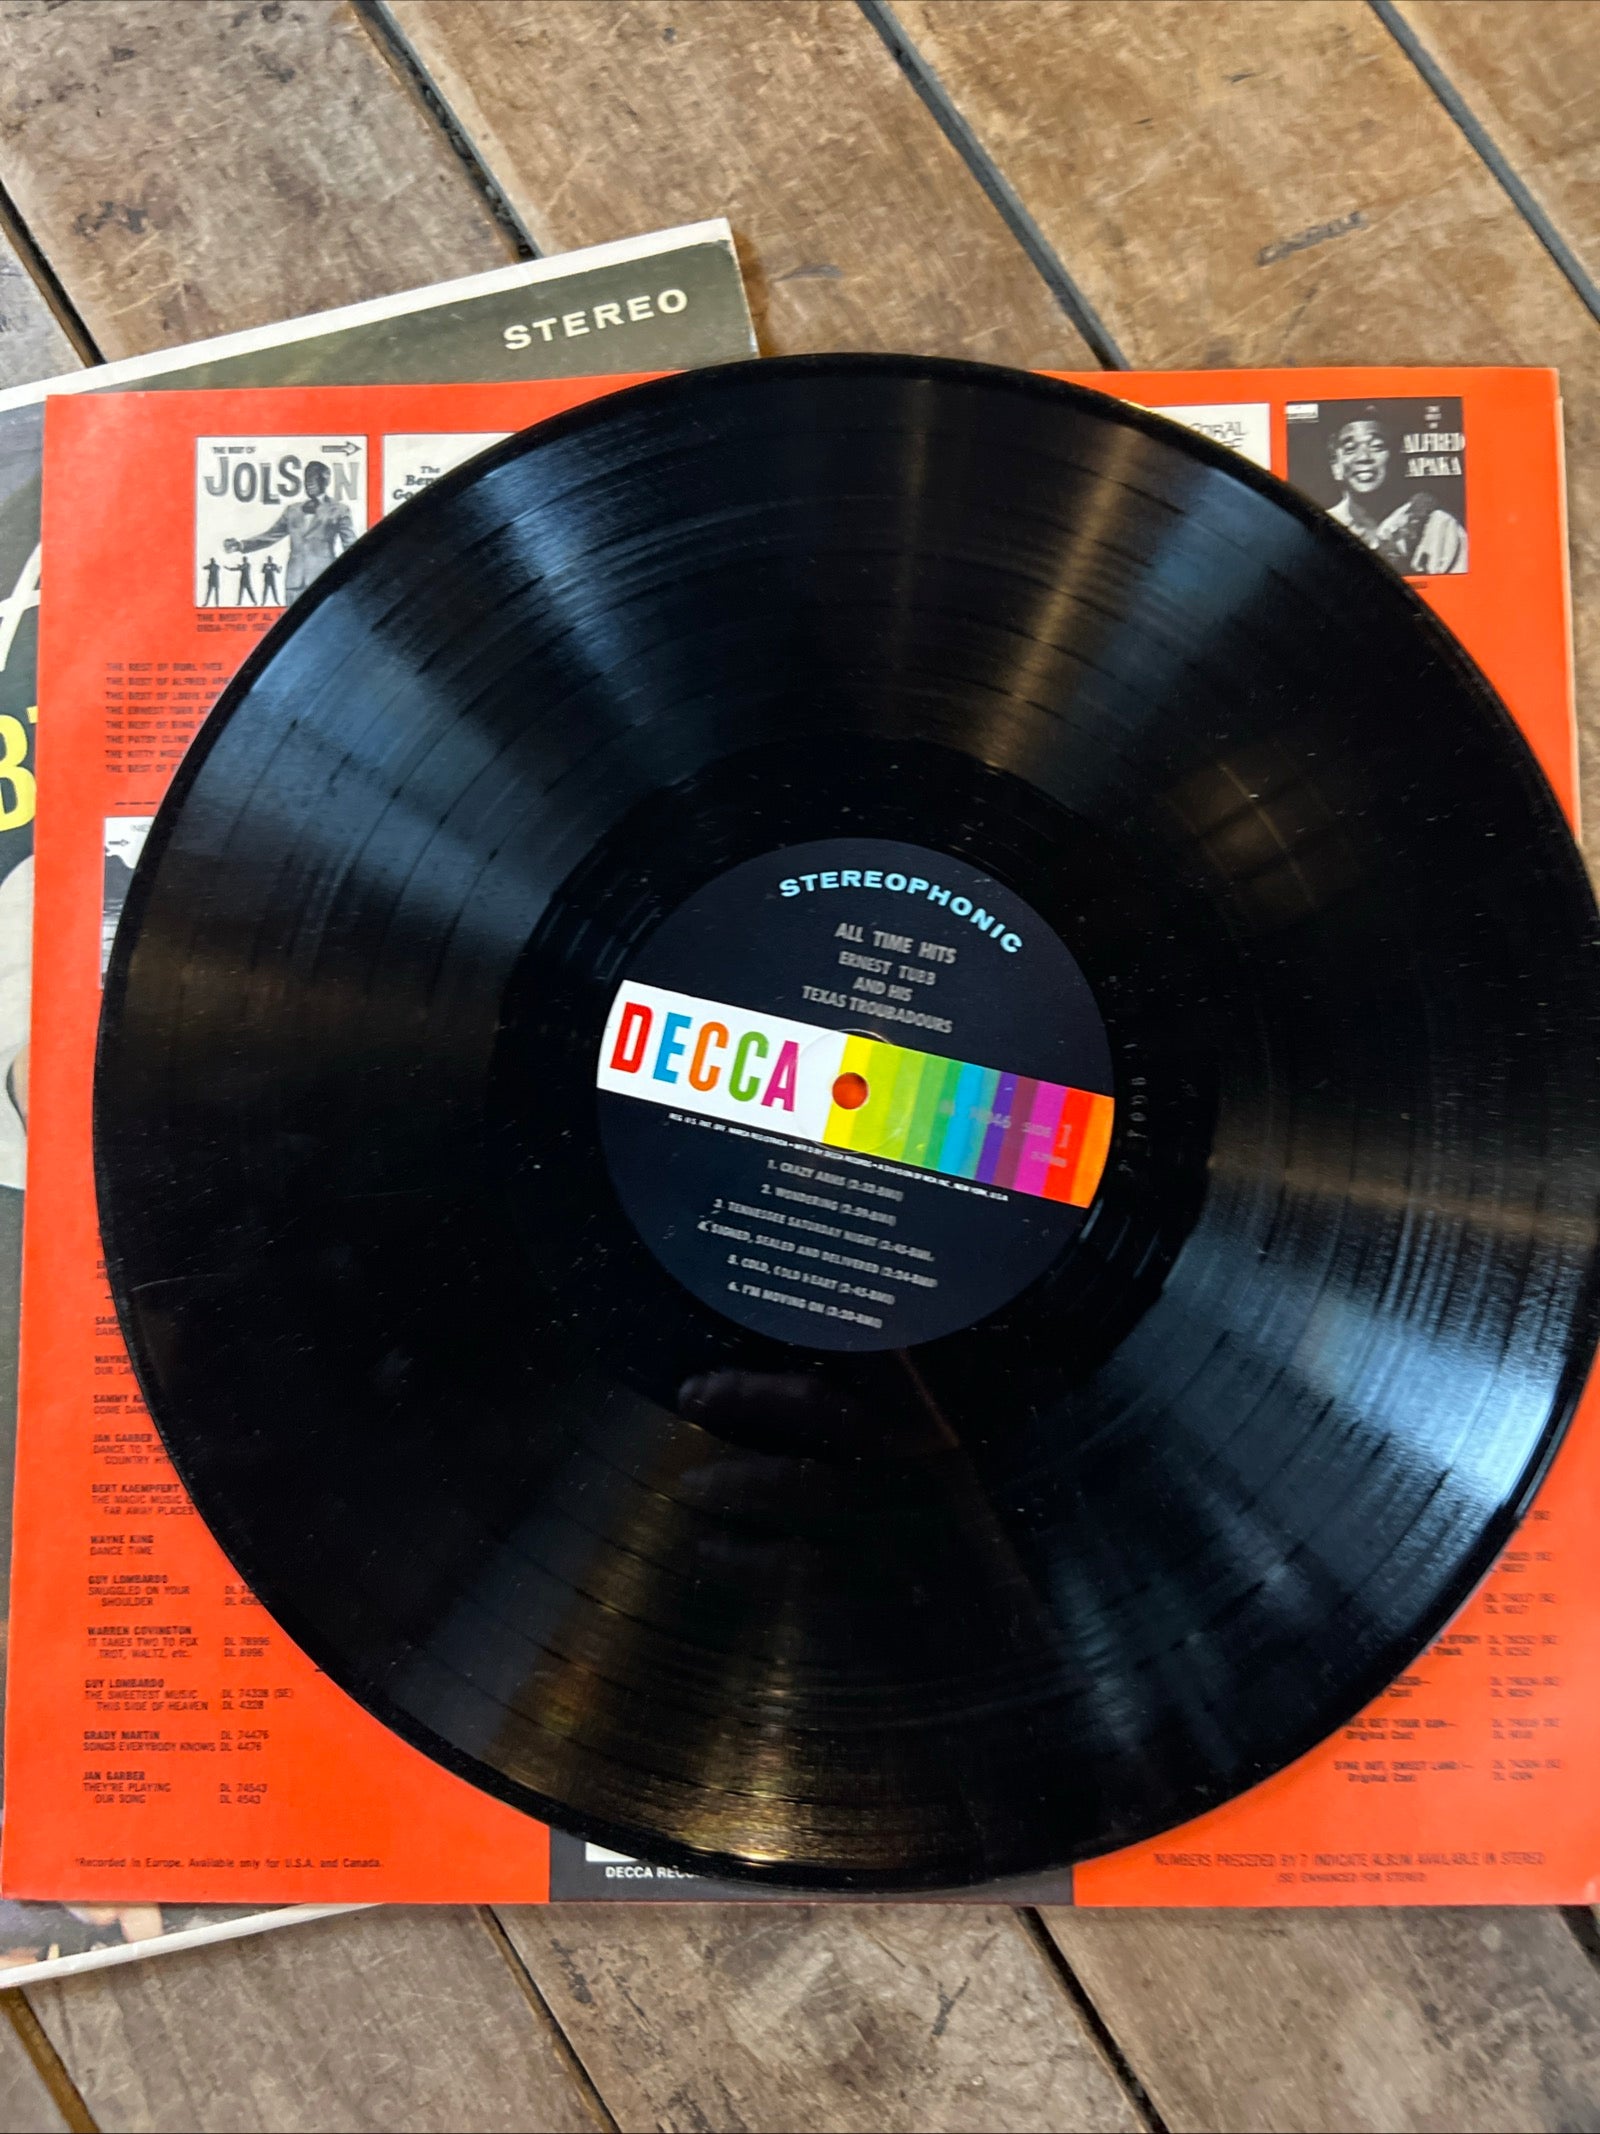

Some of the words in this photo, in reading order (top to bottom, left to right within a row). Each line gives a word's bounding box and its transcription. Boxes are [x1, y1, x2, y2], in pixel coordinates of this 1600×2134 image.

[504, 289, 688, 349] STEREO
[1401, 433, 1465, 453] ALFRED
[420, 466, 440, 474] The
[1405, 457, 1462, 477] APAKA
[203, 454, 359, 505] JOLSN
[197, 613, 214, 622] THE
[219, 613, 242, 622] BEST
[106, 662, 124, 671] THE
[129, 662, 152, 671] BEST
[157, 662, 168, 671] OF
[106, 677, 124, 686] THE
[128, 677, 152, 686] BEST
[156, 677, 168, 686] OF
[106, 692, 124, 700] THE
[128, 692, 151, 700] BEST
[106, 706, 124, 714] THE
[106, 721, 124, 729] THE
[128, 721, 152, 729] BEST
[106, 736, 124, 744] THE
[128, 736, 156, 744] PATSY
[105, 750, 122, 758] THE
[106, 764, 124, 773] THE
[128, 764, 152, 773] BEST
[779, 870, 1023, 953] STEREOPHONIC
[834, 922, 864, 942] ALL
[873, 930, 914, 954] TIME
[918, 942, 957, 964] HITS
[838, 951, 893, 975] ERNEST
[899, 965, 937, 986] TUBB
[853, 976, 886, 995] AND
[888, 985, 913, 1002] HIS
[802, 985, 847, 1008] TEXAS
[849, 996, 953, 1034] TROUBADOURS
[610, 1002, 799, 1112] DECCA
[1022, 1122, 1051, 1138] SIDE
[1058, 1124, 1072, 1148] 1
[768, 1160, 777, 1170] 1.
[780, 1162, 815, 1178] CRAZY
[815, 1170, 846, 1186] ARMS
[761, 1184, 772, 1194] 2.
[775, 1187, 838, 1211] WONDERING
[728, 1201, 786, 1224] TENNESSEE
[787, 1216, 842, 1238] SATURDAY
[843, 1229, 878, 1246] NIGHT
[711, 1223, 753, 1244] SIGNED,
[755, 1234, 796, 1252] SEALED
[796, 1245, 820, 1258] AND
[821, 1251, 880, 1274] DELIVERED
[741, 1258, 771, 1274] COLD,
[727, 1281, 740, 1292] 6.
[762, 1289, 806, 1308] MOVING
[808, 1301, 826, 1314] ON
[95, 1366, 113, 1375] OUR
[94, 1395, 128, 1403] SAMMY
[94, 1406, 120, 1414] COME
[94, 1434, 110, 1442] JAN
[115, 1434, 152, 1442] GARBER
[94, 1445, 125, 1454] DANCE
[130, 1445, 142, 1454] TO
[104, 1456, 150, 1464] COUNTRY
[92, 1484, 117, 1492] BERT
[122, 1484, 180, 1492] KAEMPFERT
[92, 1495, 109, 1504] THE
[115, 1495, 146, 1504] MAGIC
[151, 1495, 182, 1504] MUSIC
[104, 1506, 122, 1515] FAR
[126, 1506, 152, 1515] AWAY
[158, 1506, 194, 1515] PLACES
[90, 1535, 125, 1544] WAYNE
[130, 1535, 154, 1544] KING
[90, 1546, 122, 1556] DANCE
[129, 1546, 152, 1556] TIME
[88, 1575, 109, 1584] GUY
[113, 1575, 168, 1584] LOMBARDO
[88, 1586, 141, 1595] SNUGGLED
[146, 1586, 158, 1595] ON
[165, 1586, 190, 1595] YOUR
[101, 1597, 153, 1606] SHOULDER
[88, 1626, 130, 1635] WARREN
[134, 1626, 192, 1635] COVINGTON
[88, 1638, 96, 1647] IT
[102, 1638, 132, 1647] TAKES
[137, 1638, 158, 1647] TWO
[163, 1638, 175, 1647] TO
[180, 1638, 198, 1647] FOX
[224, 1637, 236, 1646] DL
[100, 1650, 127, 1659] TROT,
[172, 1650, 192, 1658] etc.
[224, 1648, 236, 1657] DL
[85, 1679, 104, 1688] GUY
[109, 1679, 164, 1688] LOMBARDO
[85, 1690, 104, 1700] THE
[108, 1690, 160, 1700] SWEETEST
[165, 1690, 198, 1700] MUSIC
[222, 1689, 233, 1698] DL
[97, 1702, 120, 1711] THIS
[124, 1702, 147, 1711] SIDE
[152, 1702, 164, 1711] OF
[168, 1702, 208, 1711] HEAVEN
[222, 1700, 234, 1710] DL
[84, 1731, 116, 1740] GRADY
[121, 1731, 160, 1740] MARTIN
[221, 1730, 232, 1740] DL
[83, 1742, 116, 1752] SONGS
[119, 1742, 176, 1752] EVERYBODY
[180, 1742, 216, 1752] KNOWS
[220, 1742, 232, 1751] DL
[83, 1772, 101, 1781] JAN
[106, 1772, 145, 1781] GARBER
[83, 1783, 124, 1792] THEY'RE
[128, 1783, 171, 1792] PLAYING
[220, 1784, 232, 1792] DL
[95, 1794, 114, 1804] OUR
[119, 1794, 146, 1804] SONG
[220, 1795, 232, 1804] DL
[132, 1858, 141, 1867] in
[146, 1858, 184, 1869] Europe.
[189, 1858, 234, 1868] Available
[240, 1858, 259, 1869] only
[266, 1858, 280, 1868] for
[285, 1858, 315, 1868] U.S.A.
[320, 1858, 338, 1868] and
[343, 1858, 381, 1868] Canada.
[1154, 1853, 1212, 1867] NUMBERS
[1217, 1853, 1275, 1867] PRECEDED
[1315, 1853, 1368, 1866] INDICATE
[1417, 1852, 1480, 1865] AVAILABLE
[1500, 1852, 1545, 1865] STEREO
[605, 1866, 654, 1878] DECCA
[1301, 1872, 1356, 1883] ENHANCED
[1360, 1872, 1382, 1883] FOR
[1386, 1872, 1426, 1883] STEREO
